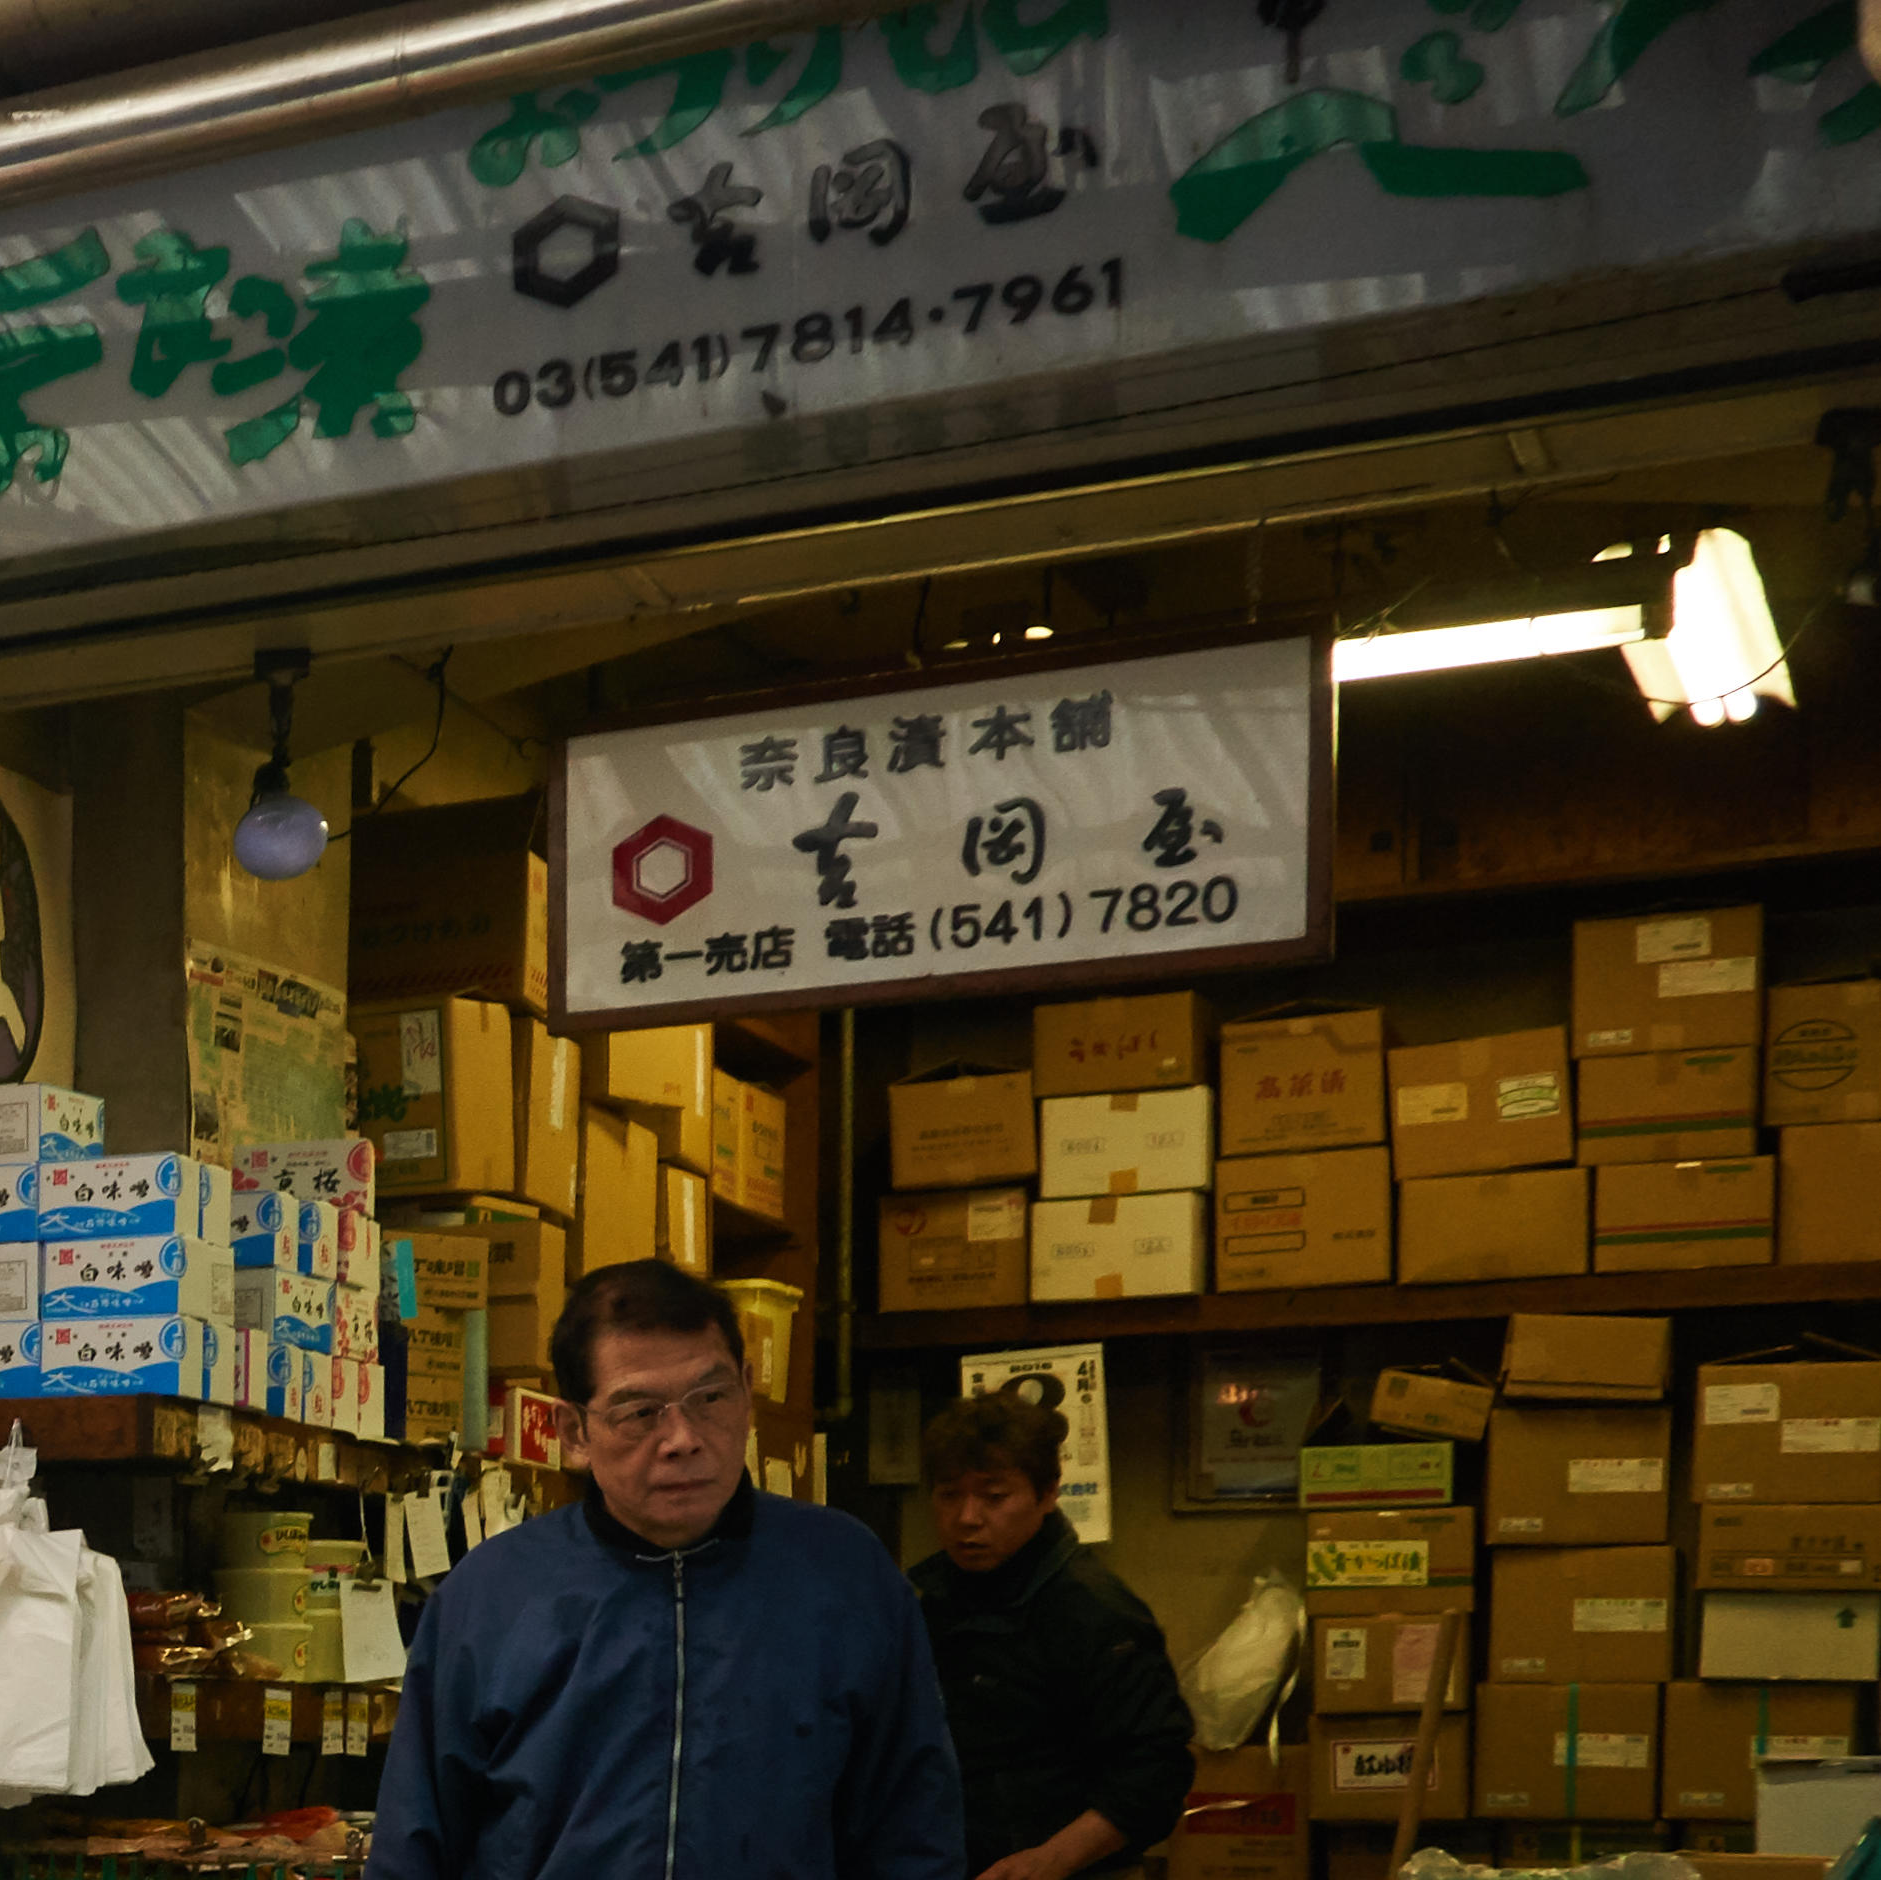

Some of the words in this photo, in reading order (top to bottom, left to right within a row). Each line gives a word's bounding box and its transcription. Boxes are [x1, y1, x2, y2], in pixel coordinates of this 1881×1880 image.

[619, 925, 797, 984] 第一売店
[825, 912, 918, 965] 電話
[928, 890, 1075, 954] (541)
[1089, 874, 1239, 937] 7820
[74, 1177, 151, 1203] 白味噌
[80, 1257, 155, 1284] 白味噌
[77, 1339, 155, 1364] 白味噌
